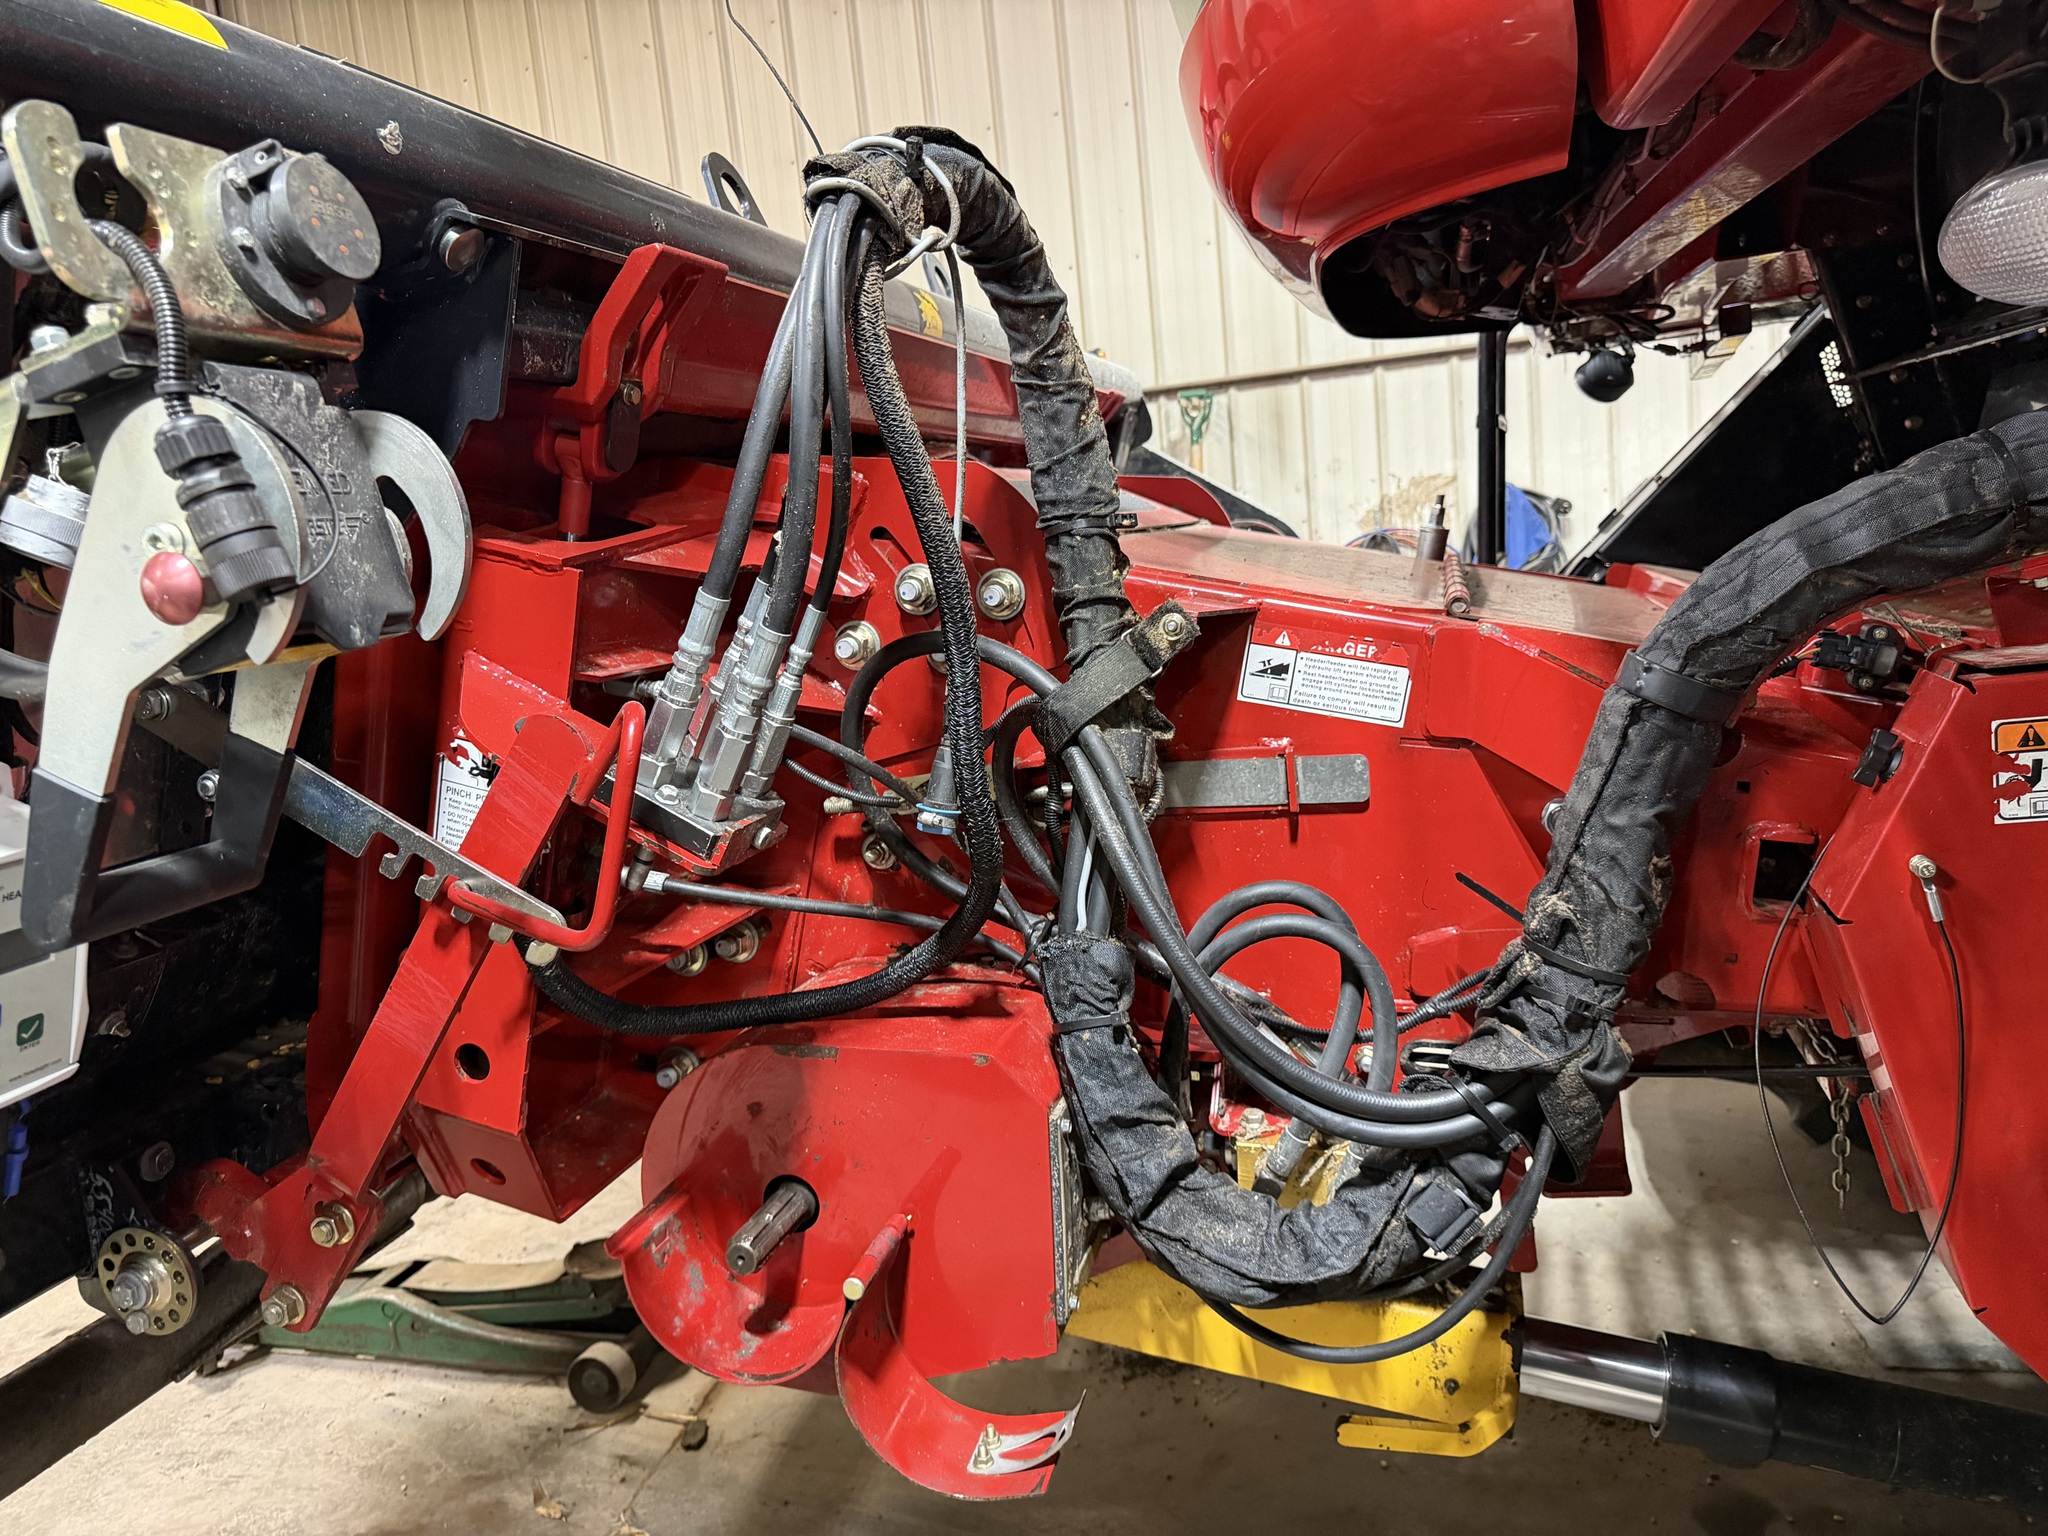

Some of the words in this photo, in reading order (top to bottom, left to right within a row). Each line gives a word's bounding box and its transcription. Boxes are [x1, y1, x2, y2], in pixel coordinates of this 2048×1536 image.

[1365, 672, 1387, 680] should
[1301, 676, 1323, 684] engage
[1333, 681, 1358, 690] cylinder
[1368, 680, 1391, 689] ground
[1294, 690, 1317, 698] Failure
[1327, 695, 1352, 704] comply
[1366, 701, 1387, 709] result
[1322, 702, 1347, 710] serious
[446, 786, 471, 799] PINCH
[449, 797, 462, 805] Keep
[441, 837, 460, 847] Failur
[3, 890, 22, 902] HEA
[20, 1040, 41, 1052] ENTER
